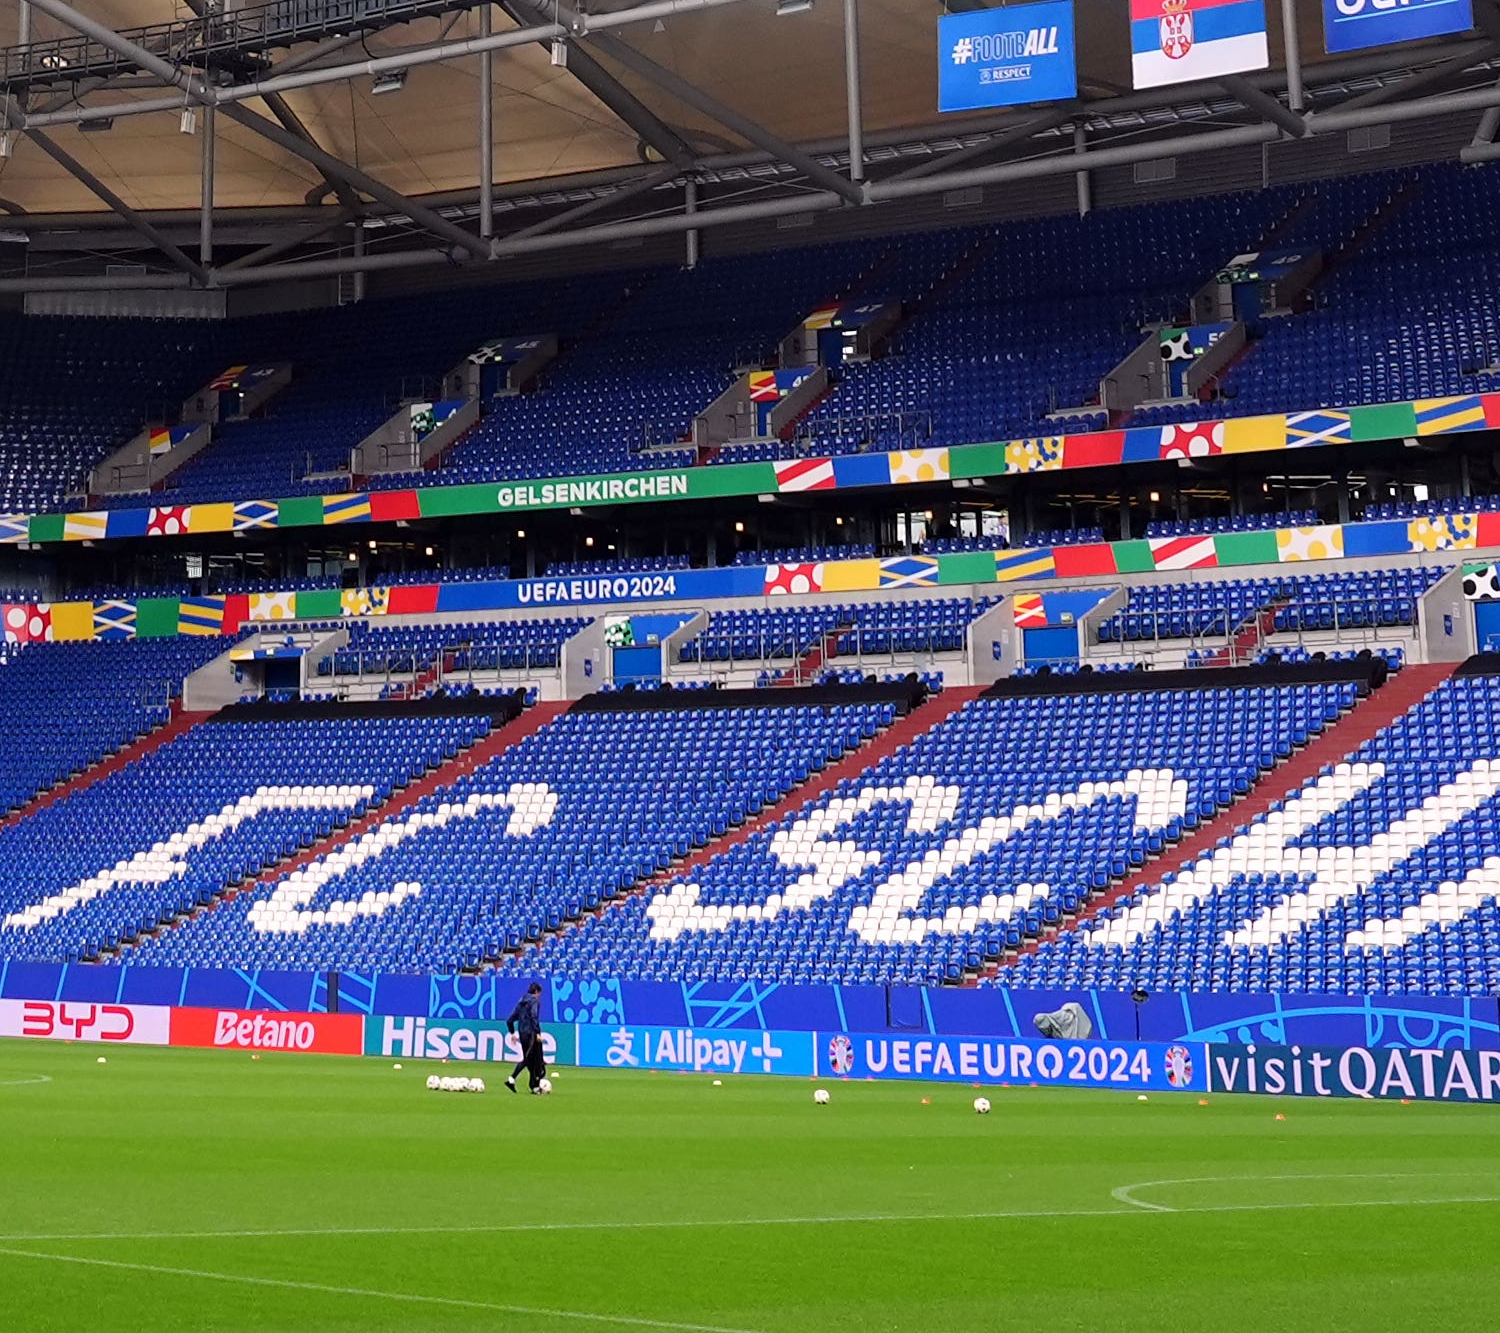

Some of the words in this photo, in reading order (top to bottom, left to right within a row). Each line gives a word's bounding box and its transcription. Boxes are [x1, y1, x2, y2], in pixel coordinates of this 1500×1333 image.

[952, 26, 1059, 64] #FOOTBALL
[993, 67, 1031, 80] RESPECT
[498, 473, 688, 507] GELSENKIRCHEN
[22, 1001, 134, 1040] BYD
[213, 1010, 315, 1049] Betano
